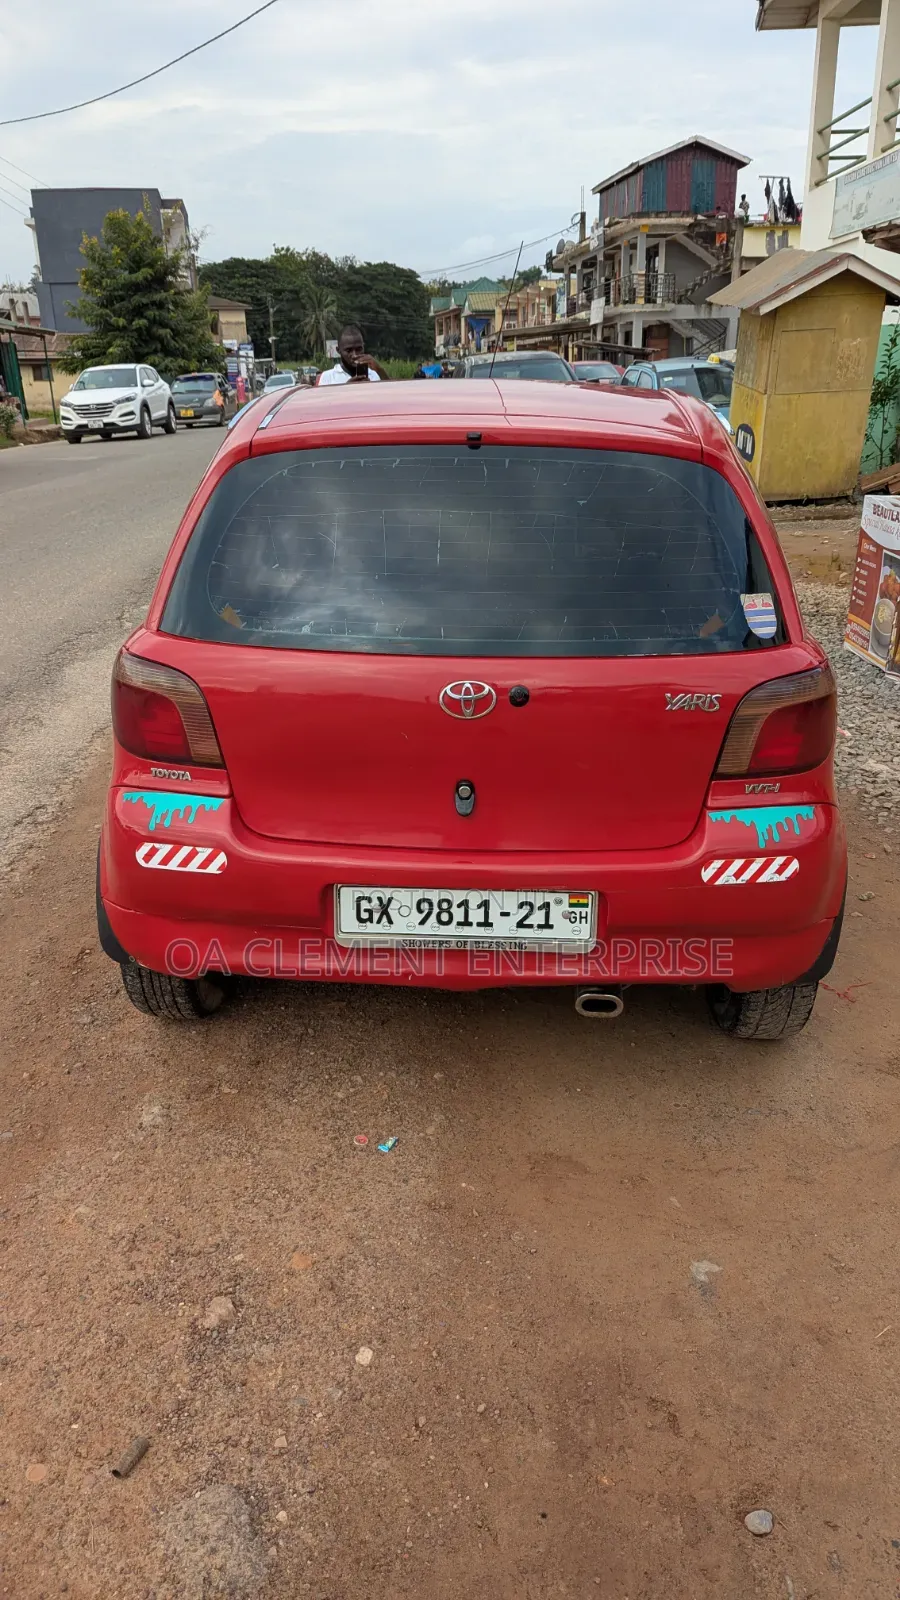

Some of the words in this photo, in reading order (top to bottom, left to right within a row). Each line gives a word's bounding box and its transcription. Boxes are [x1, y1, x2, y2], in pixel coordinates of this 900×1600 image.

[737, 428, 753, 455] MTN
[151, 767, 192, 781] TOYOTA
[355, 895, 394, 925] GX
[415, 897, 554, 929] 9811-21
[568, 910, 588, 925] GH
[401, 938, 452, 949] SHOWERS
[456, 940, 469, 949] OF
[474, 940, 528, 951] BLESSING
